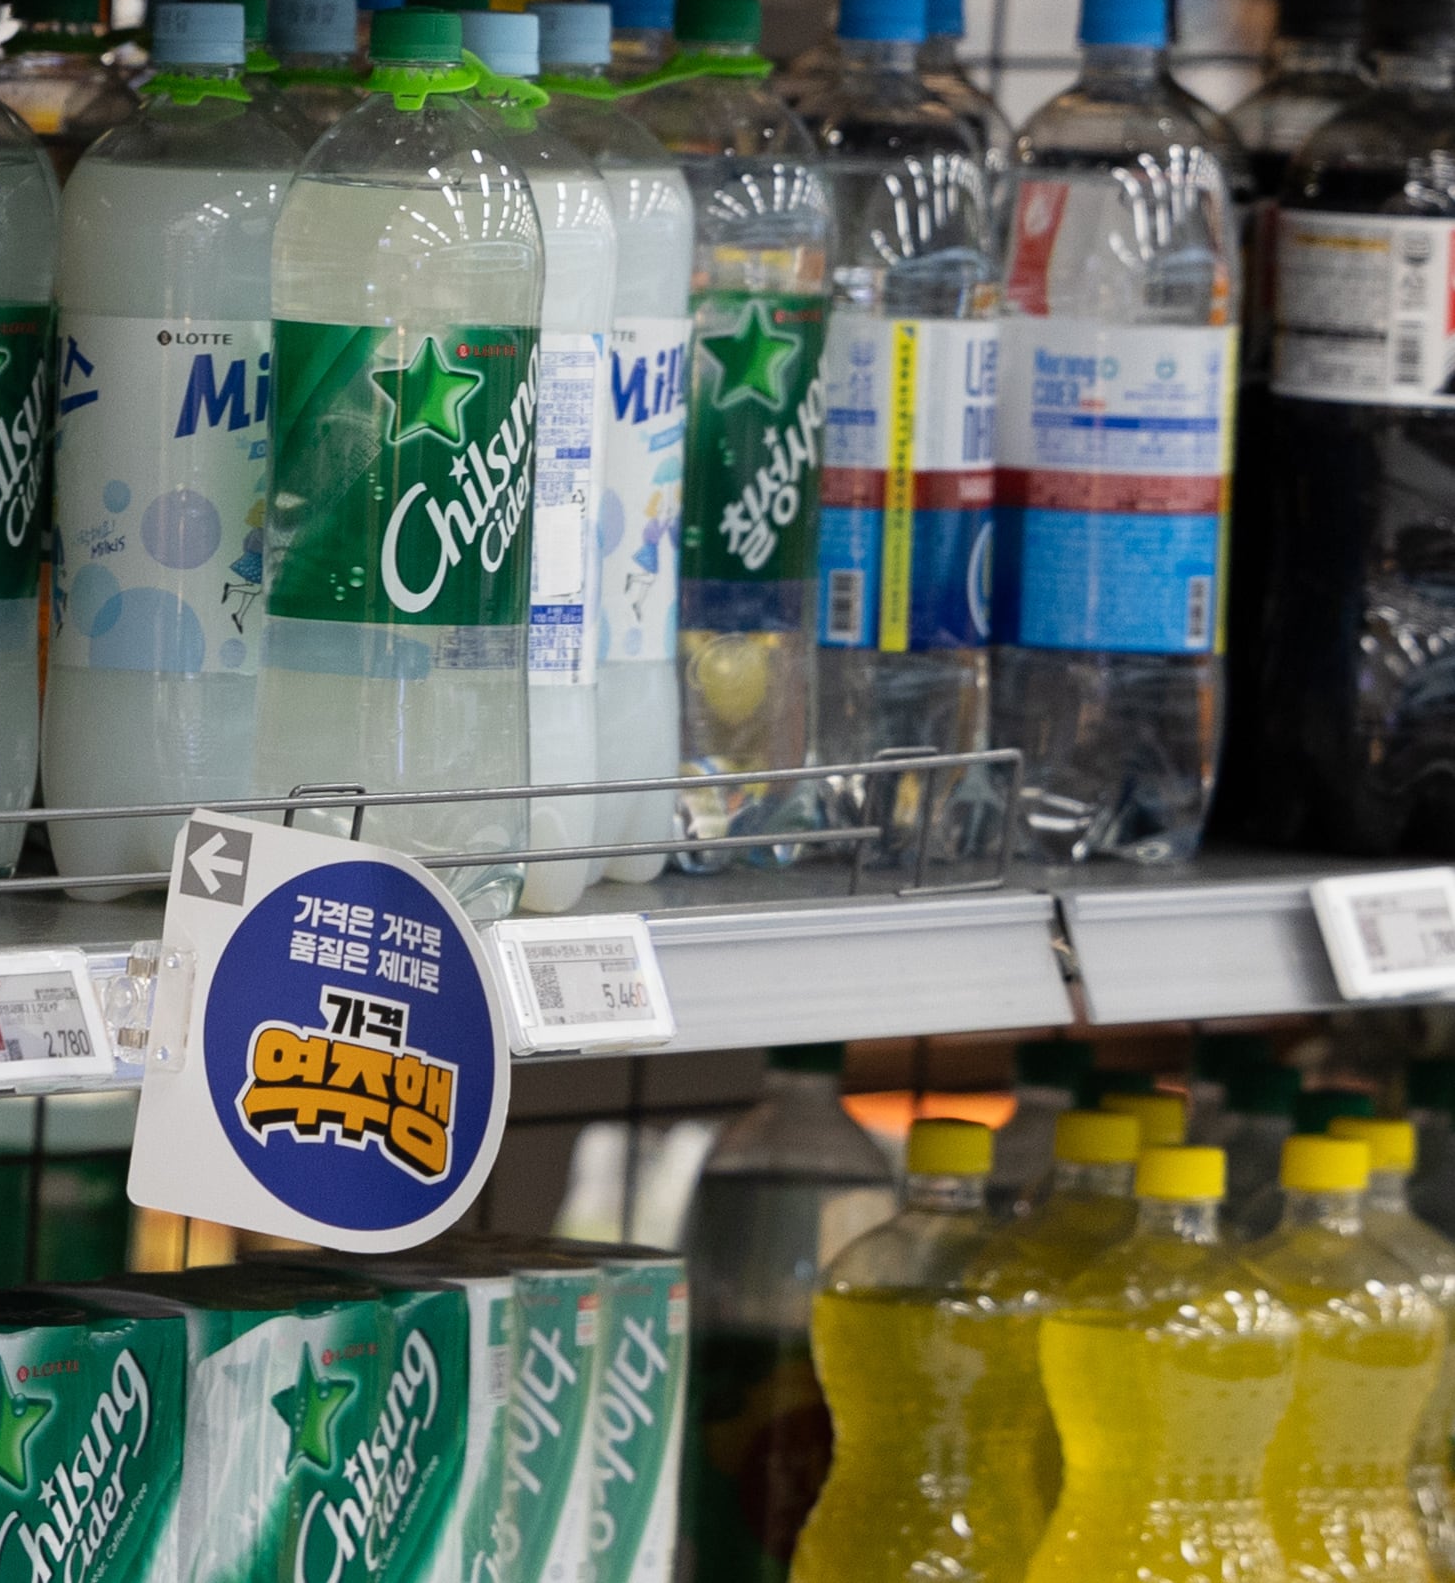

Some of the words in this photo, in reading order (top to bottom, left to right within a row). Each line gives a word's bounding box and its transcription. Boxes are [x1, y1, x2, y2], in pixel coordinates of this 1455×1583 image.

[176, 332, 233, 345] LOTTE
[611, 330, 637, 342] TTE
[609, 342, 685, 425] Mil
[480, 440, 532, 573] Cider
[294, 894, 374, 939] 가격은
[381, 912, 442, 959] 거꾸로
[289, 930, 369, 976] 품질은
[376, 949, 439, 994] 제대로
[326, 993, 406, 1048] 가격
[601, 982, 648, 1010] 5,460
[43, 1029, 91, 1058] 2,780
